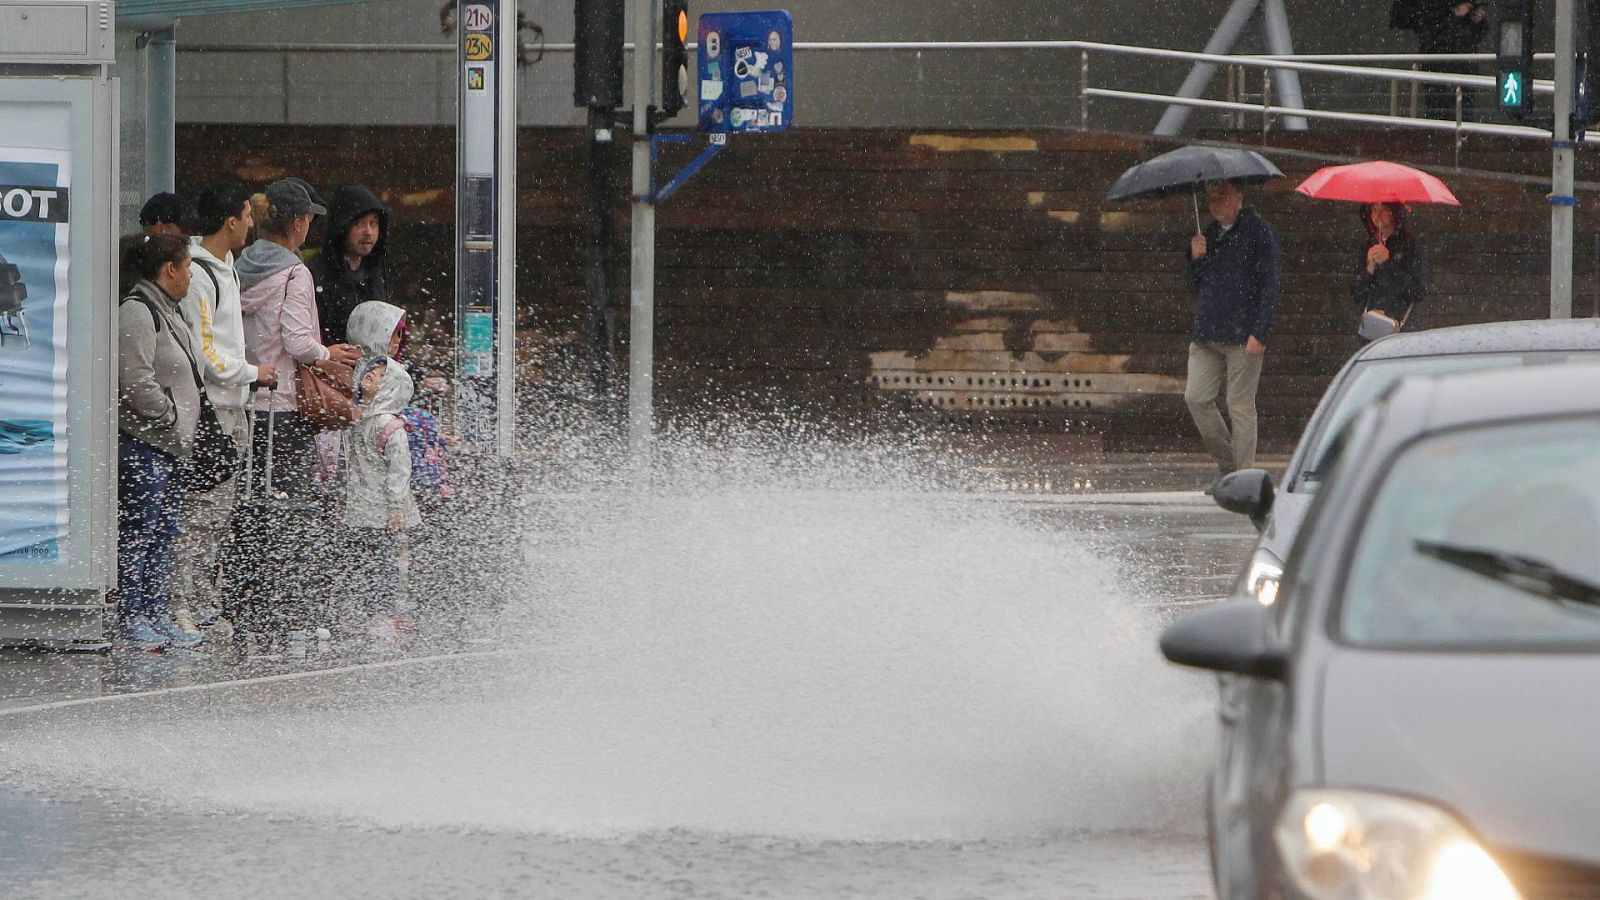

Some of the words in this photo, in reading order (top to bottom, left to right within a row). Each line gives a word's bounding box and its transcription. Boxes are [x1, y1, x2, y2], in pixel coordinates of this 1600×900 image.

[465, 8, 490, 26] 21N
[466, 38, 490, 55] 23N
[0, 188, 57, 218] OT
[31, 547, 49, 555] 1000
